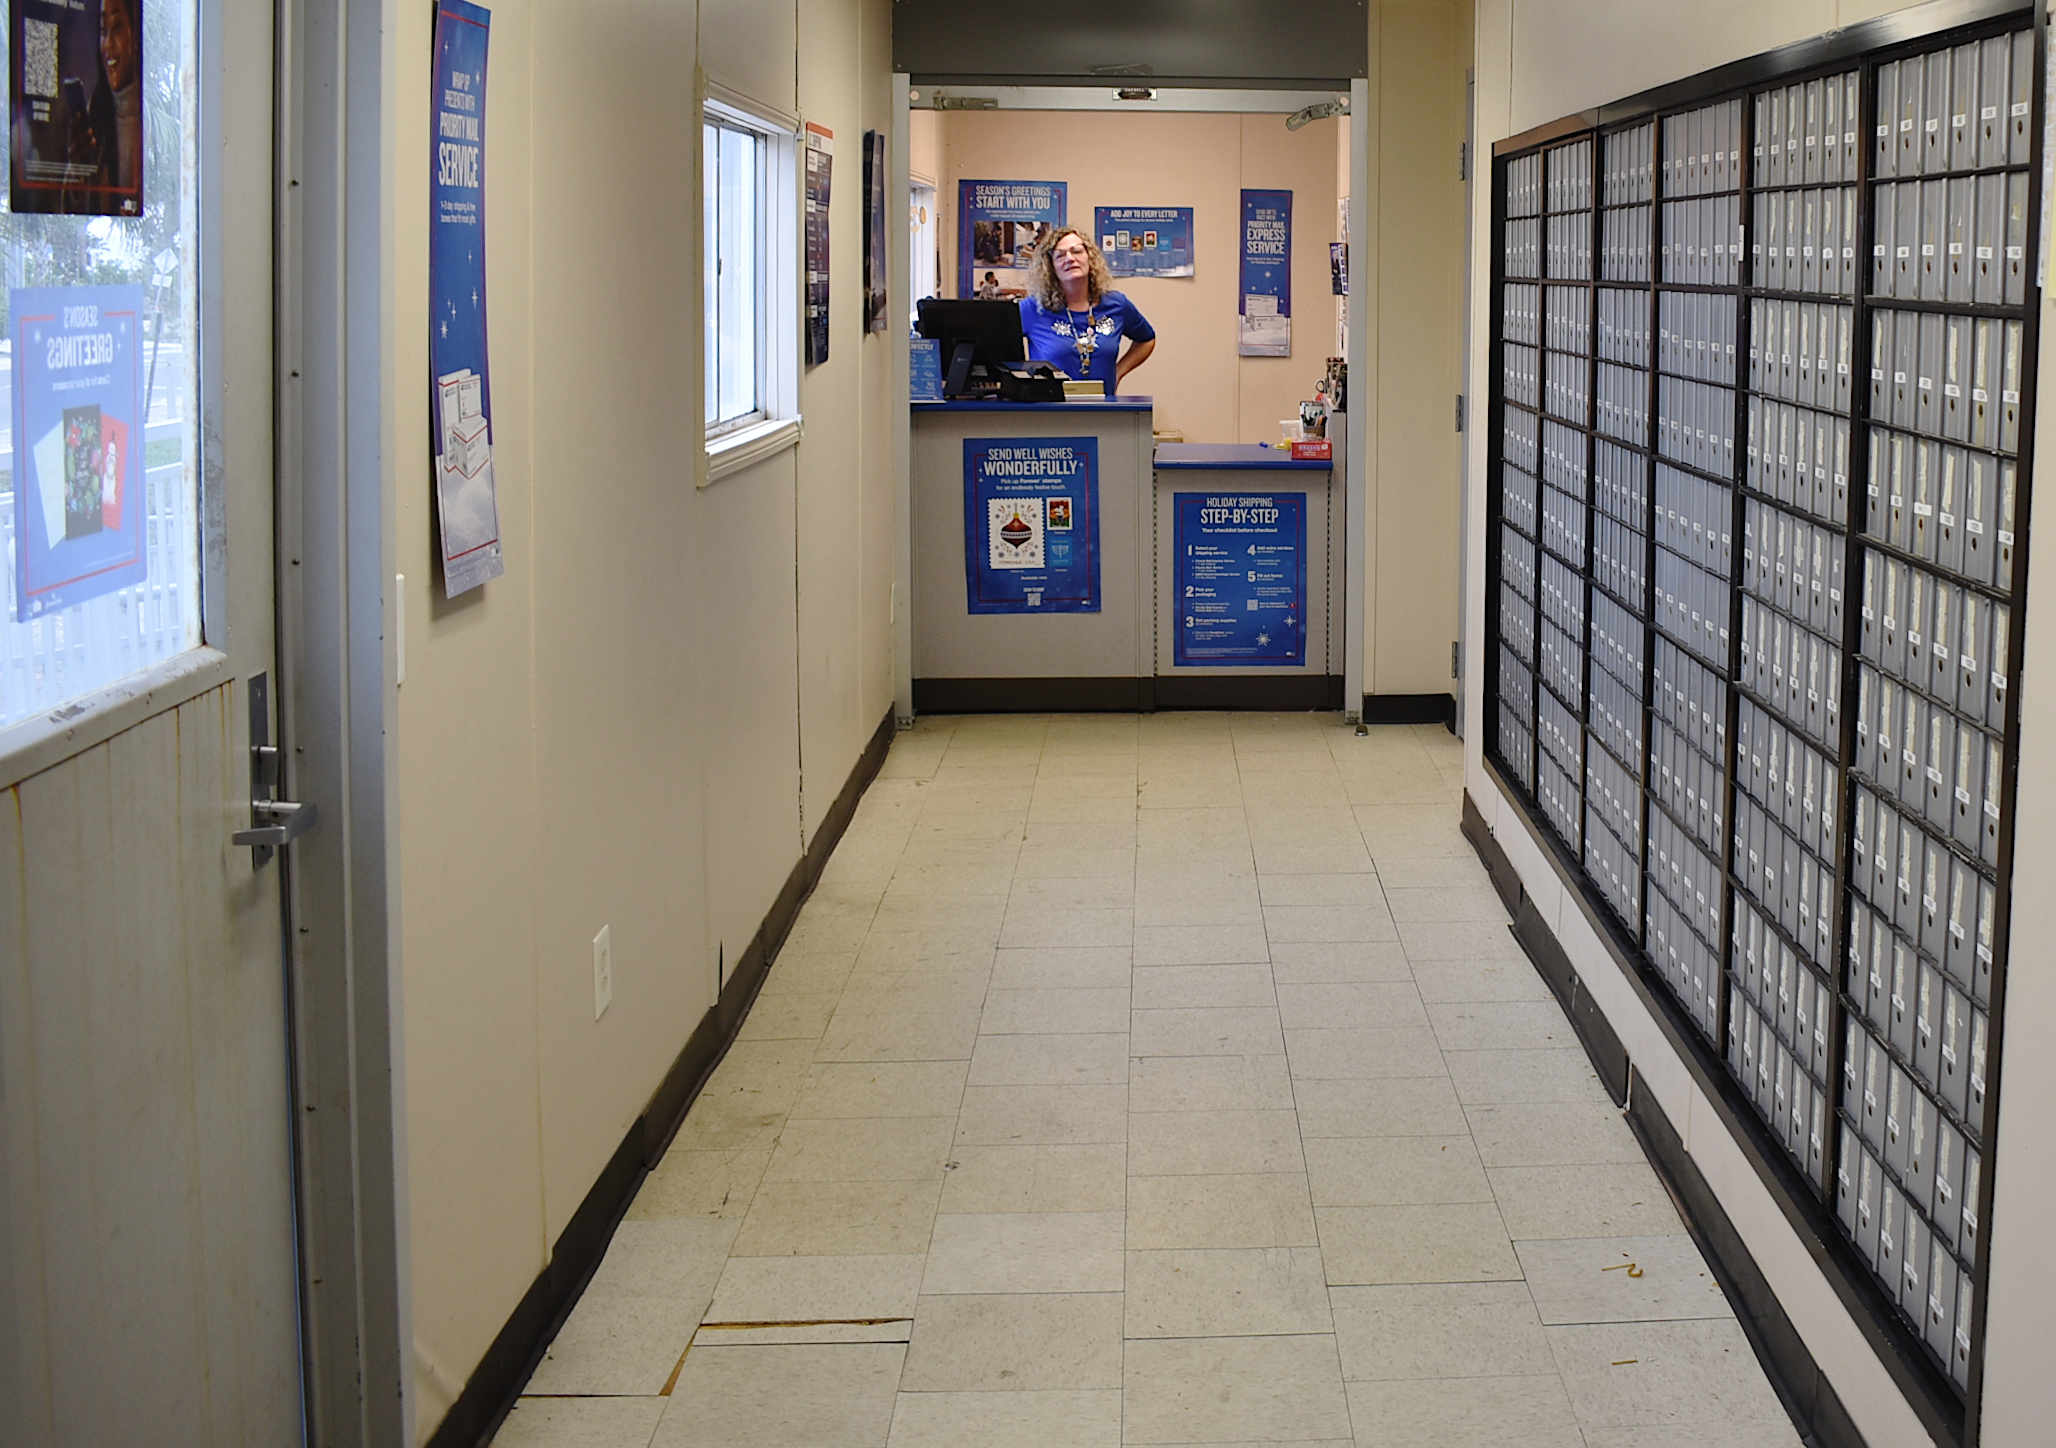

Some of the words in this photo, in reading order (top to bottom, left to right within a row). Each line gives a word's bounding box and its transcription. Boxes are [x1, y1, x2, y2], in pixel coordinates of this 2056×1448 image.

[440, 112, 465, 139] PRIORITY
[466, 117, 479, 142] MAIL
[438, 142, 479, 188] SERVICE
[976, 185, 1010, 196] SEASON'S
[1011, 186, 1051, 196] GREETINGS
[976, 197, 1004, 208] START
[1006, 197, 1030, 208] WITH
[1032, 197, 1051, 209] YOU
[1110, 210, 1122, 218] ADD
[1122, 210, 1133, 218] JOY
[1134, 210, 1141, 218] TO
[1142, 210, 1158, 218] EVERY
[1158, 210, 1178, 218] LETTER
[1248, 220, 1271, 228] PRIORITY
[1247, 228, 1286, 241] EXPRESS
[1247, 241, 1285, 254] SERVICE
[988, 448, 1012, 460] SEND
[1013, 448, 1038, 460] WELL
[1038, 447, 1073, 460] WISHES
[984, 460, 1078, 476] WONDERFULLY
[1206, 497, 1238, 507] HOLIDAY
[1238, 497, 1273, 507] SHIPPING
[1200, 508, 1279, 524] STEP-BY-STEP
[1188, 544, 1192, 556] 1
[1248, 544, 1256, 555] 4
[1248, 570, 1256, 582] 5
[1186, 586, 1194, 597] 2
[1186, 616, 1194, 627] 3
